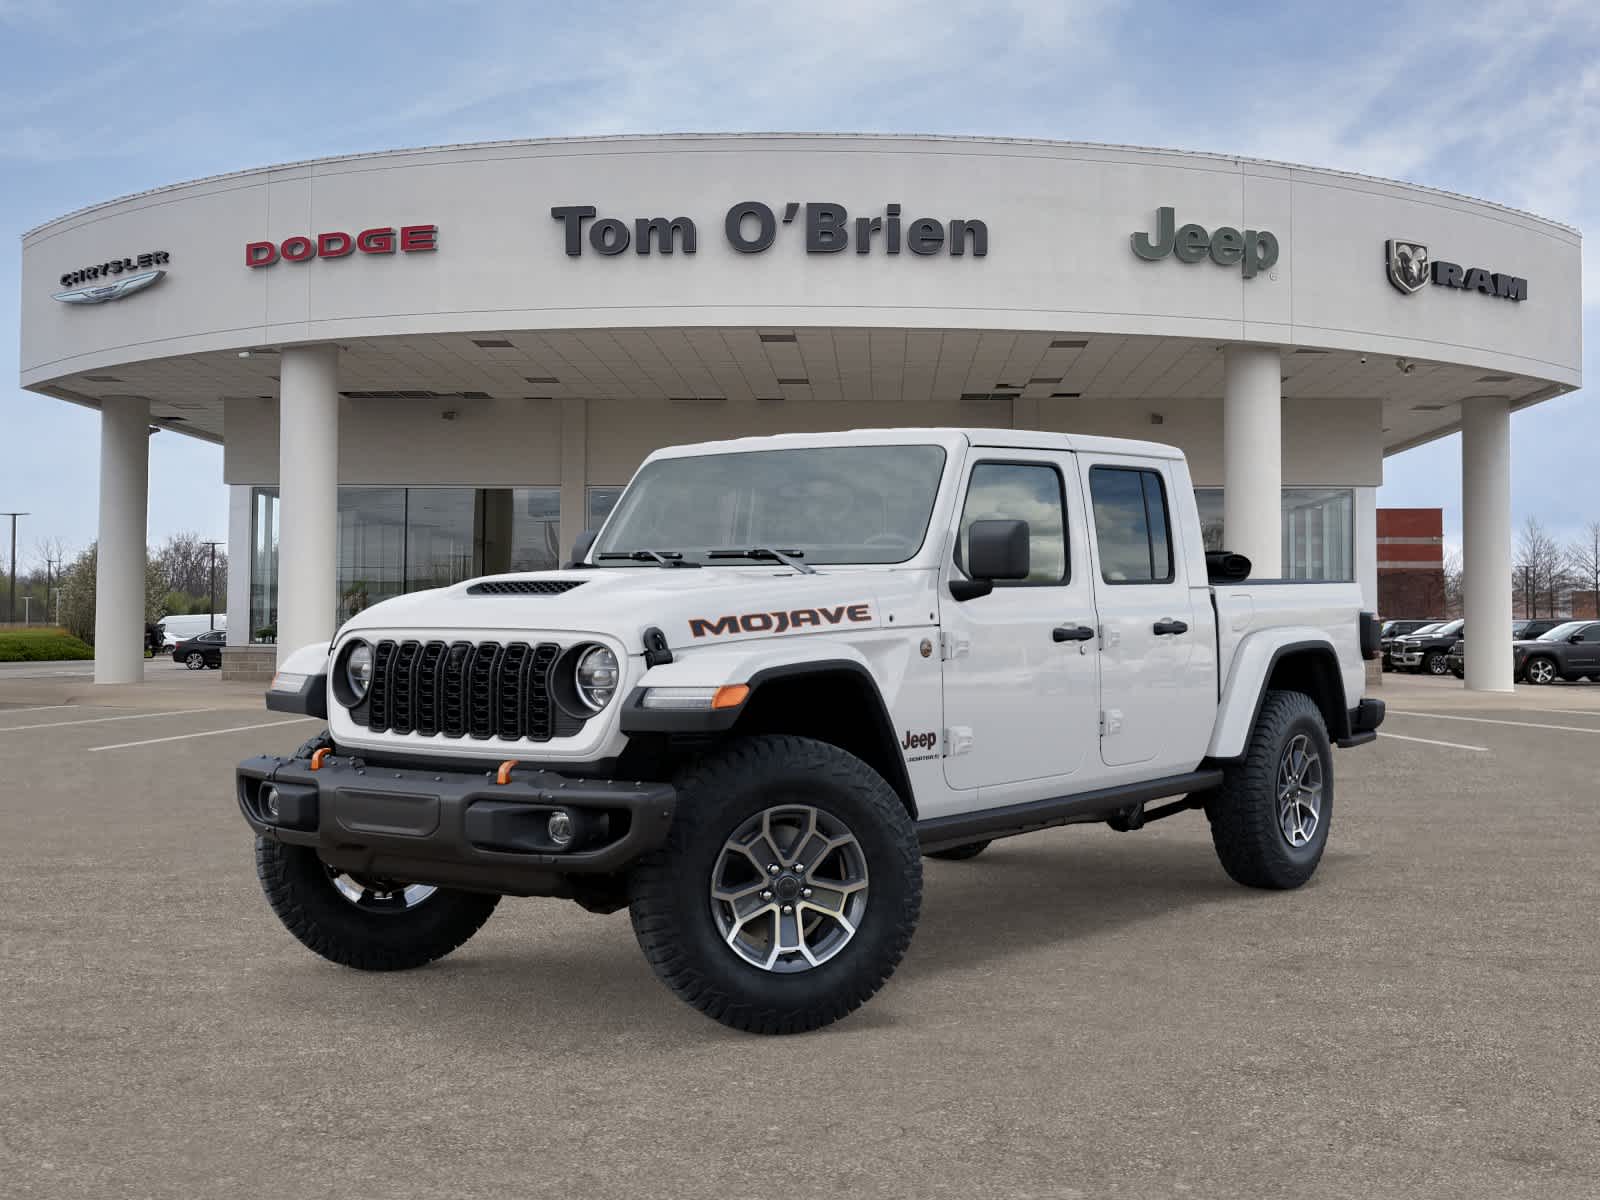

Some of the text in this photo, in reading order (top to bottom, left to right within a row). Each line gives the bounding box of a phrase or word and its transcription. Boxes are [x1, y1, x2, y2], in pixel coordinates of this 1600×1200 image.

[245, 224, 438, 269] DODGE
[551, 201, 989, 257] Tom O'Brien
[1130, 207, 1279, 279] Jeep
[60, 250, 169, 287] CHRYSLER
[1431, 260, 1528, 301] RAM
[688, 604, 872, 637] MOJAVE
[902, 730, 937, 750] Jeep
